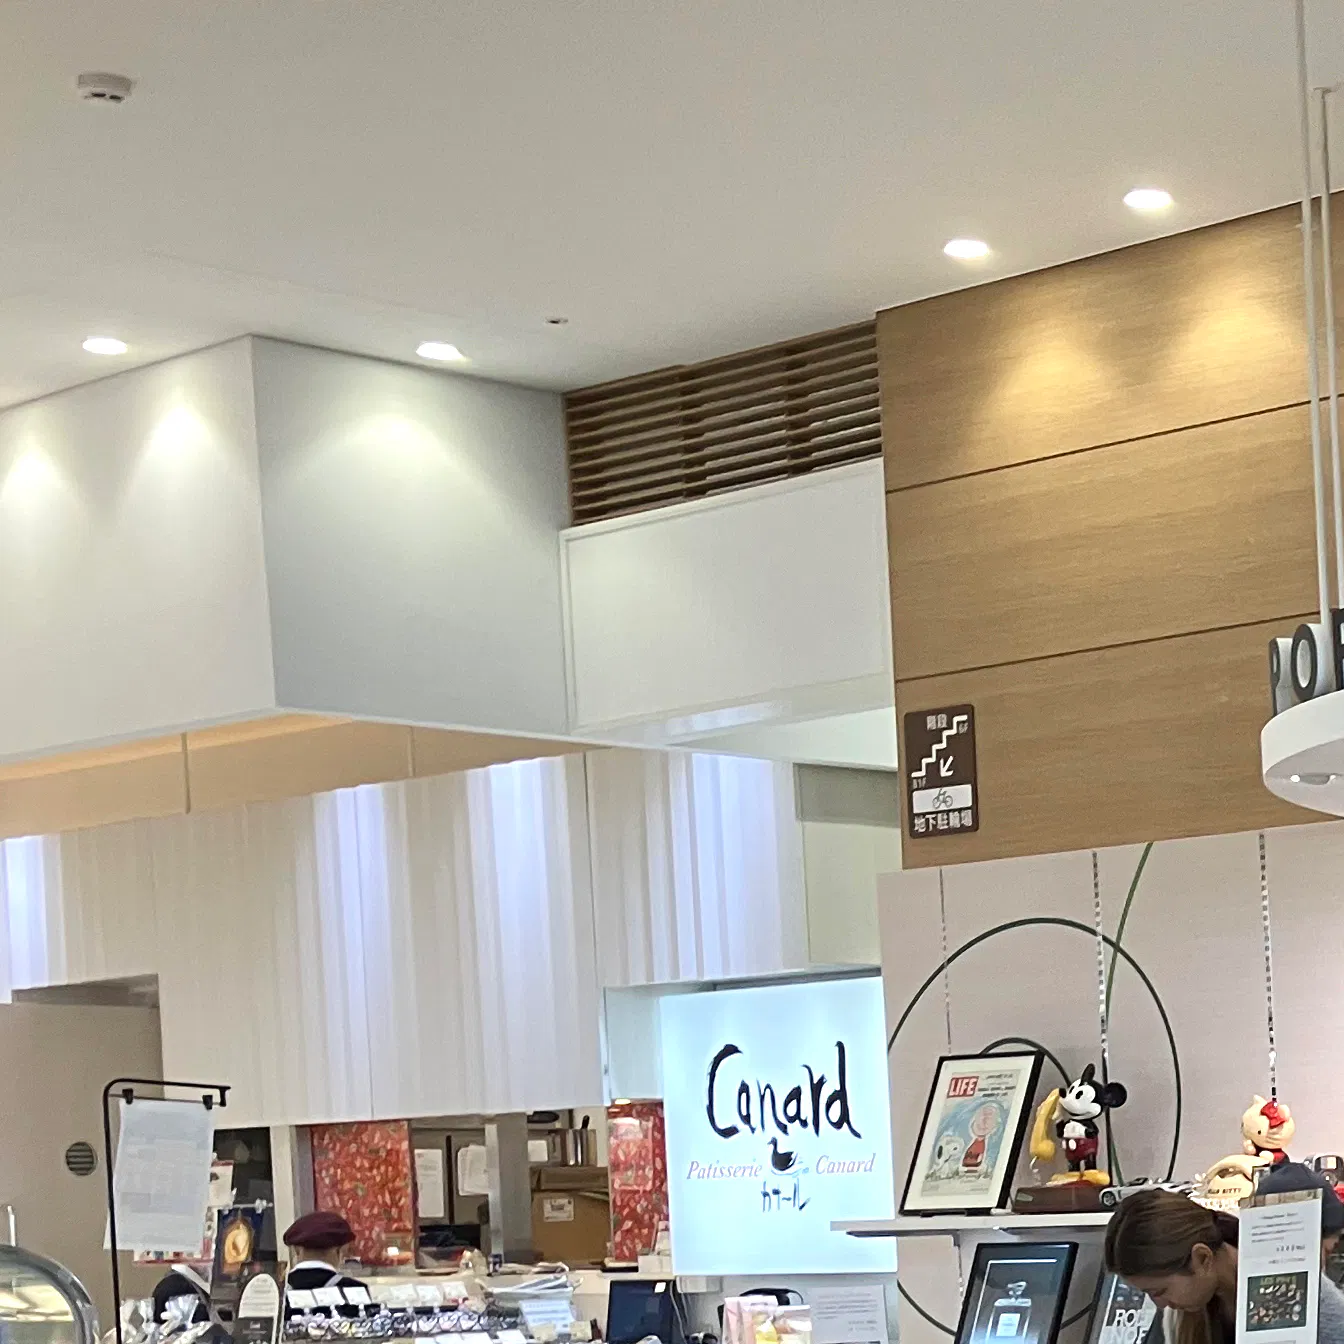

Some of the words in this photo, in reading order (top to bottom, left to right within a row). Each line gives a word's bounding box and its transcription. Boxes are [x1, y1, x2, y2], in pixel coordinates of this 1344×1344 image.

[706, 1040, 862, 1139] Canard
[949, 1077, 978, 1096] LIFE
[686, 1158, 763, 1180] Patisserie
[815, 1152, 877, 1175] Canard
